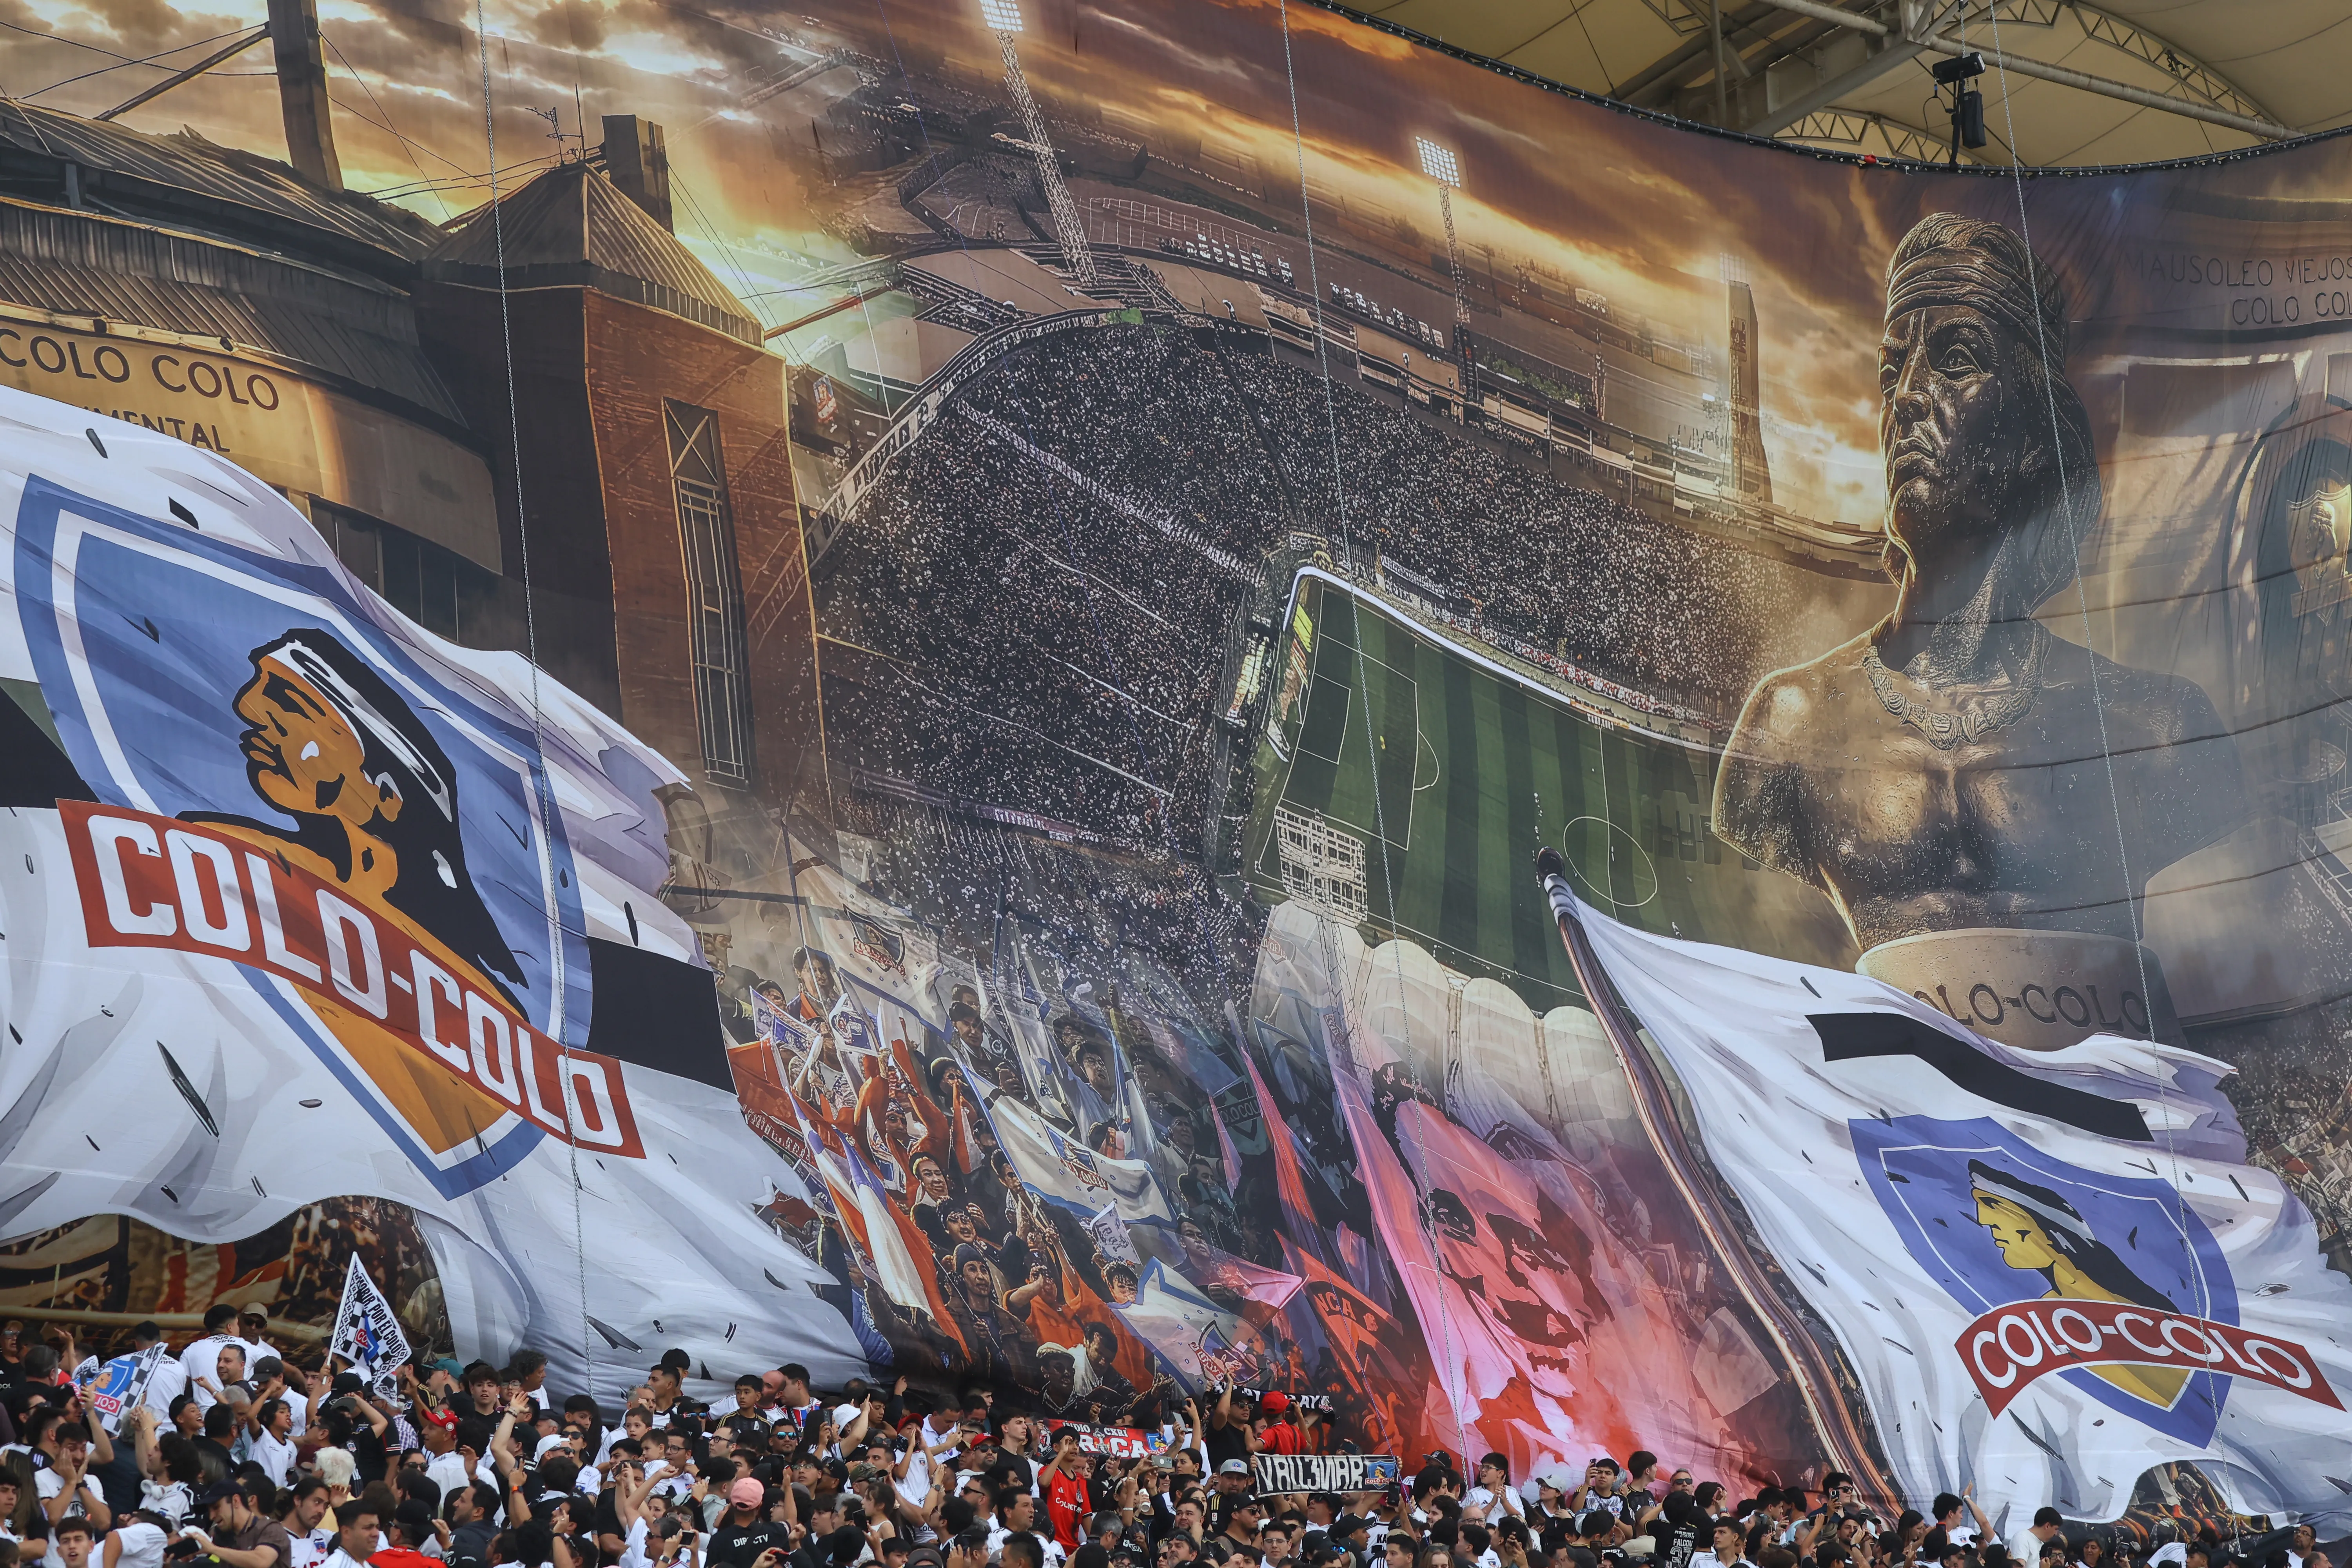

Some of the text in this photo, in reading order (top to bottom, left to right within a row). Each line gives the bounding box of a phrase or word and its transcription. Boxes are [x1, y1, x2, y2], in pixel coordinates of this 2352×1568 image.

[2125, 252, 2273, 287] MAUSOLEO
[2232, 296, 2299, 325] COLO
[151, 354, 279, 411] COLO
[87, 814, 623, 1147] COLO-COLO
[368, 1303, 387, 1325] POR
[378, 1320, 391, 1334] EL
[1972, 1307, 2312, 1389] COLO-COLO
[733, 1534, 768, 1548] DIRCTV
[1673, 1538, 1693, 1547] FALCON
[1670, 1546, 1693, 1568] 37
